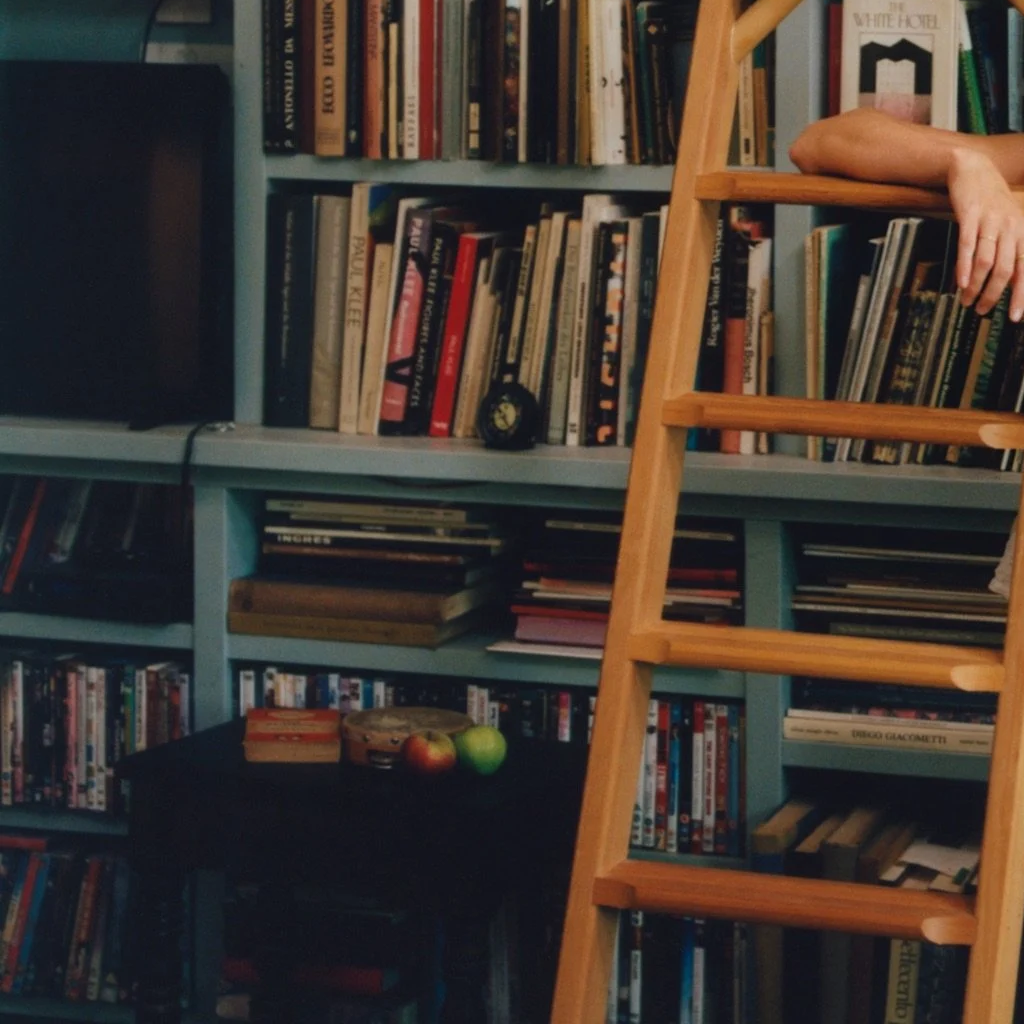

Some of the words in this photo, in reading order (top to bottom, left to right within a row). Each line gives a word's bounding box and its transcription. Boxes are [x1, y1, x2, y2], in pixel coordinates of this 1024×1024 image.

[853, 13, 893, 29] WHITE
[898, 14, 940, 30] HOTEL
[284, 37, 294, 53] DA
[284, 60, 294, 131] ANTONELLO
[321, 76, 335, 114] ECCO
[407, 217, 423, 255] PAUL
[431, 237, 443, 264] PAUL
[349, 235, 367, 280] PAUL
[402, 259, 417, 296] KLEE
[346, 286, 364, 328] KLEE
[420, 299, 435, 345] FIGURES
[416, 347, 427, 371] AND
[743, 351, 754, 384] Bosch
[410, 375, 424, 408] FACES
[276, 532, 332, 546] INGRES
[851, 728, 882, 740] DIEGO
[885, 730, 947, 745] GIACOMETTI
